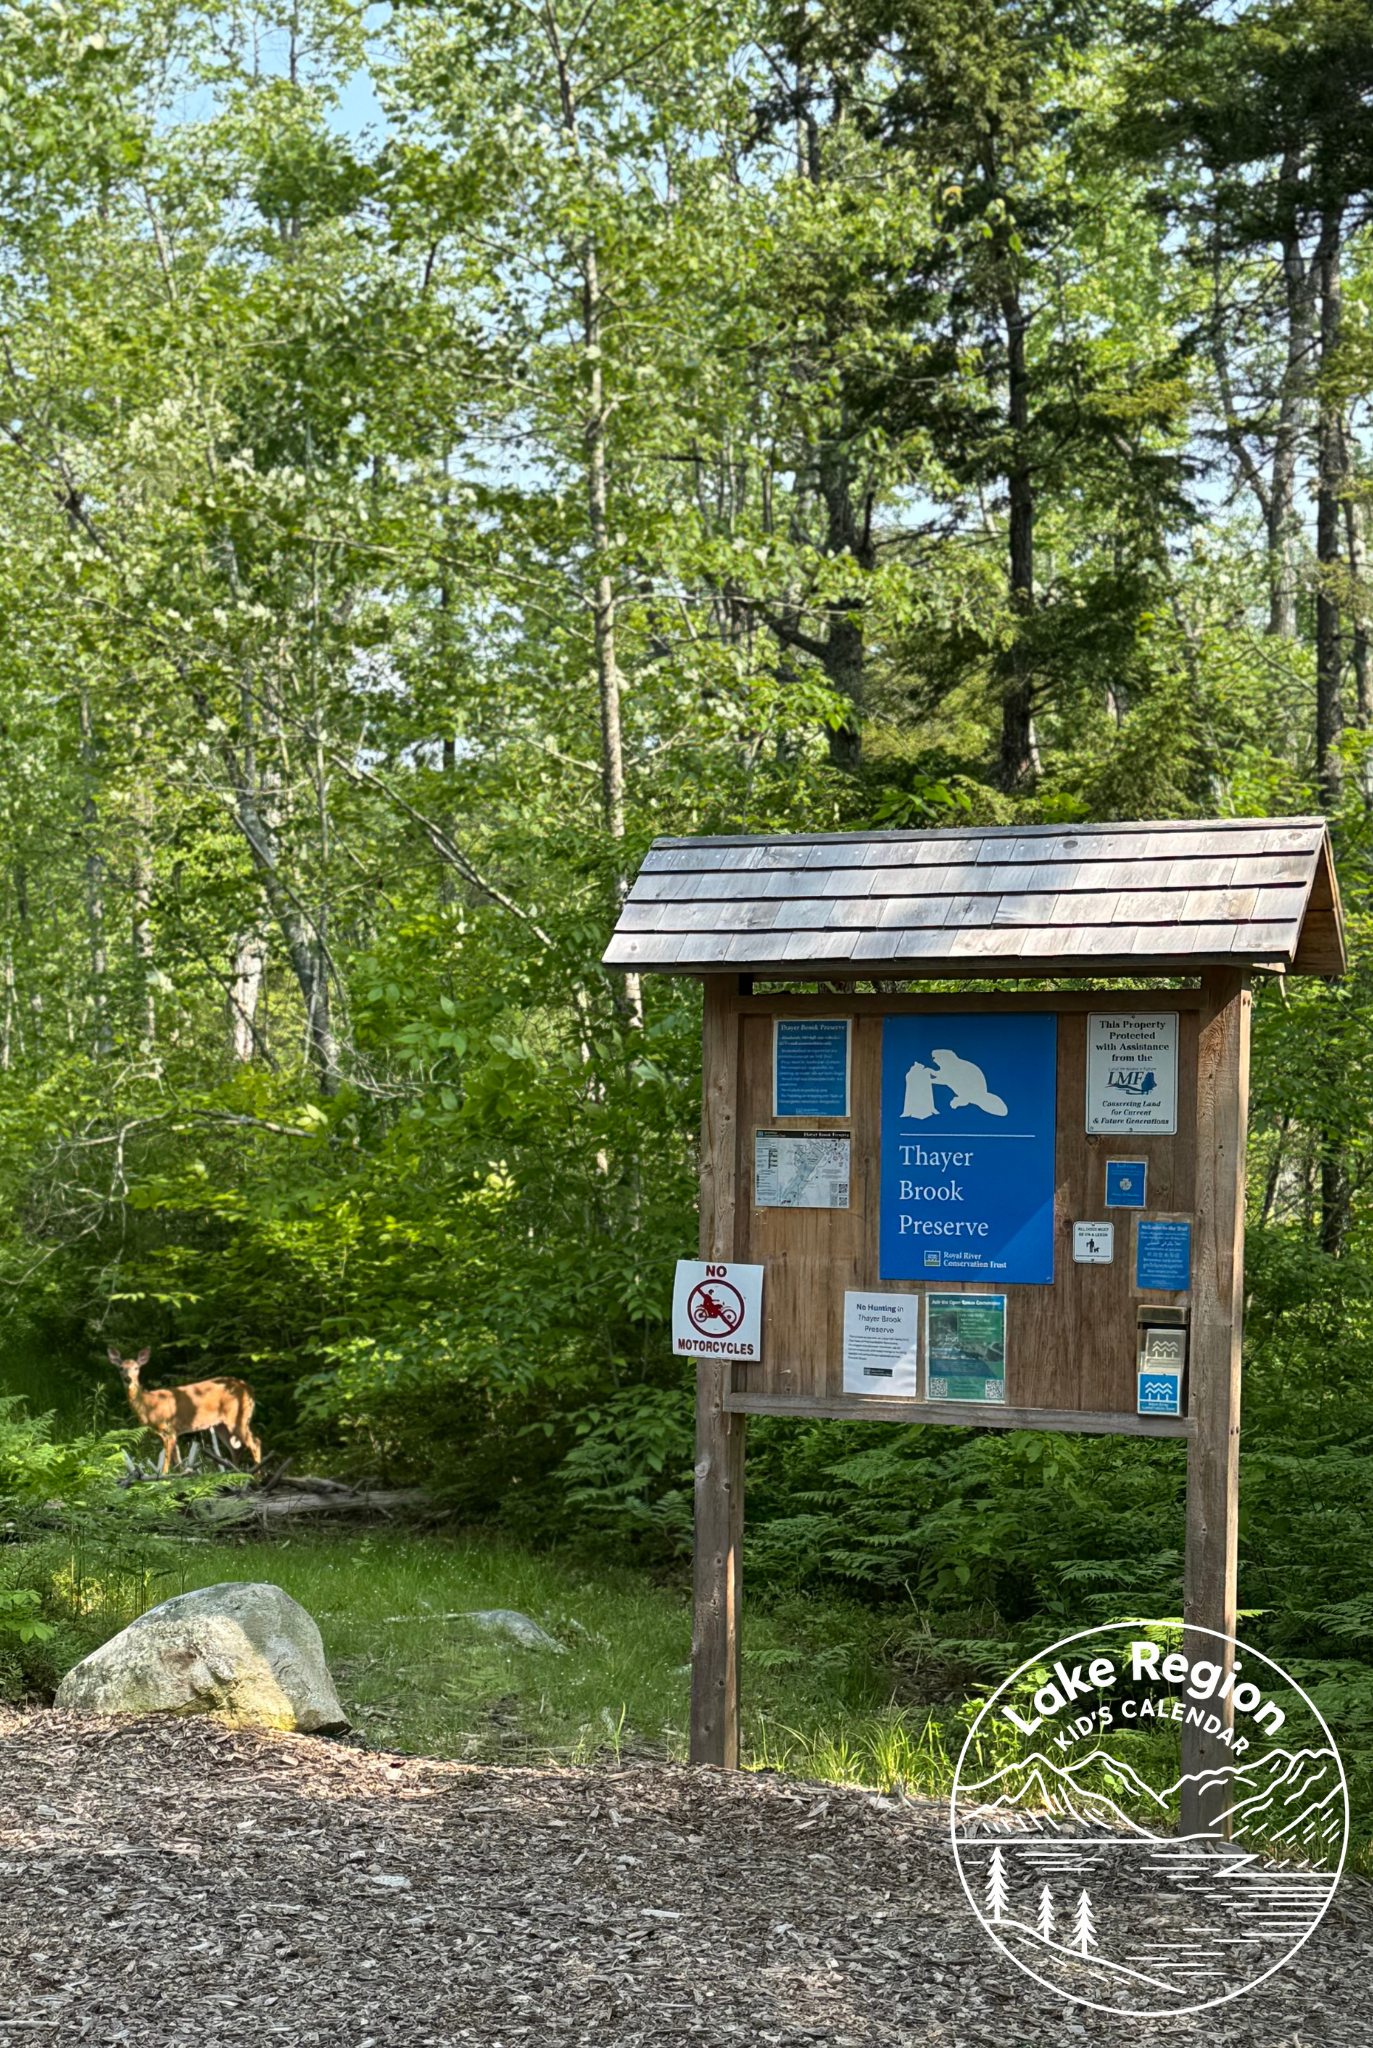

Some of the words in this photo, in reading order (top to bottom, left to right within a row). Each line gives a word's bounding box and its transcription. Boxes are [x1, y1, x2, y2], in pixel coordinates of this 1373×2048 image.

[1099, 1020, 1120, 1029] This
[1123, 1020, 1166, 1030] Property
[1109, 1031, 1156, 1040] Protected
[1096, 1043, 1117, 1051] with
[1119, 1043, 1170, 1051] Assistance
[1111, 1054, 1135, 1062] from
[1137, 1054, 1153, 1062] the
[1107, 1071, 1144, 1085] LMF
[899, 1144, 974, 1173] Thayer
[899, 1180, 964, 1201] Brook
[898, 1214, 989, 1237] Preserve
[943, 1251, 962, 1260] Royal
[963, 1252, 982, 1260] River
[943, 1260, 988, 1268] Conservation
[990, 1261, 1007, 1269] Trust
[705, 1265, 728, 1278] NO
[856, 1303, 867, 1311] No
[867, 1303, 897, 1313] Hunting
[858, 1314, 880, 1323] Thayer
[881, 1315, 902, 1323] Brook
[864, 1325, 894, 1334] Preserve
[677, 1338, 754, 1355] MOTORCYCLES
